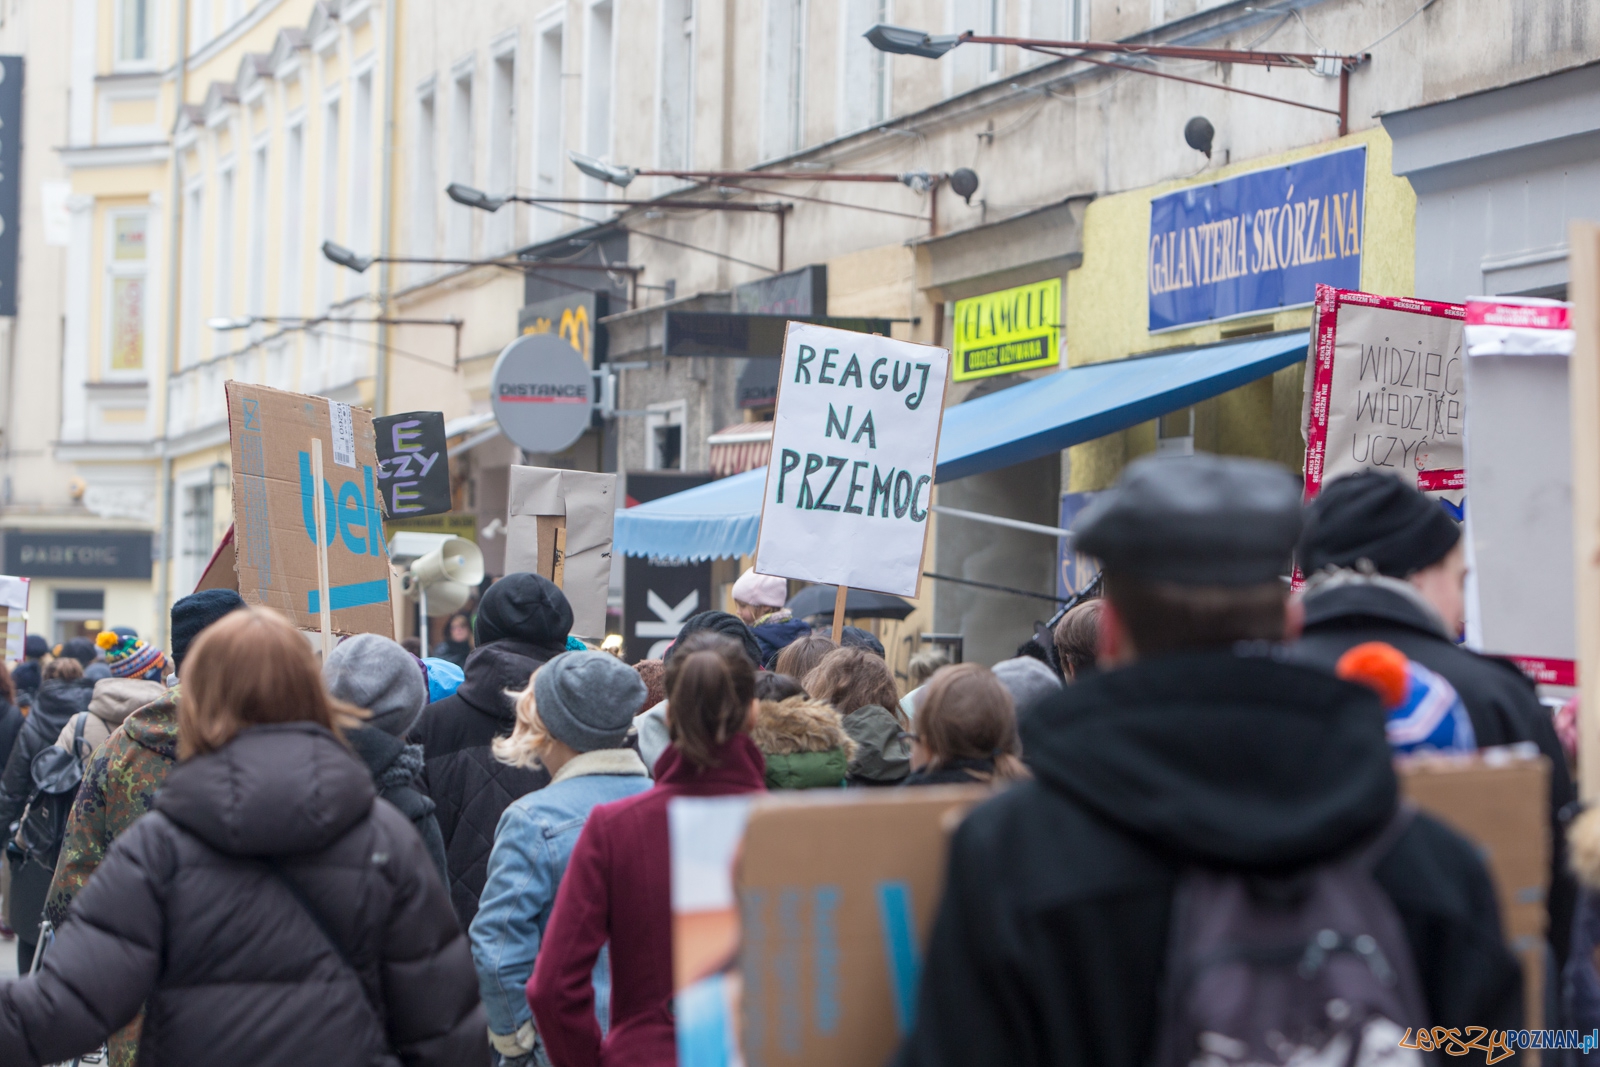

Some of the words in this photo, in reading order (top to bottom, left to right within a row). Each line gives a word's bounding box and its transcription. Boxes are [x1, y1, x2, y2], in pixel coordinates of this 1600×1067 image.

[1150, 213, 1249, 296] GALANTERIA
[1252, 184, 1360, 275] SKÓRZANA
[1340, 294, 1368, 303] SEKSIZM
[1393, 301, 1421, 310] SEKSIZM
[1324, 339, 1332, 369] SEKSIZM
[1359, 336, 1461, 396] WIDZIEĆ
[499, 383, 588, 397] DISTANCE
[795, 344, 931, 410] REAGUJ
[825, 402, 877, 449] NA
[1318, 396, 1327, 426] SEKSIZM
[392, 420, 422, 453] E
[1312, 454, 1321, 483] SEKSIZM
[1353, 435, 1428, 471] UCZYĆ
[392, 481, 425, 513] E
[776, 448, 931, 523] PRZEMOC
